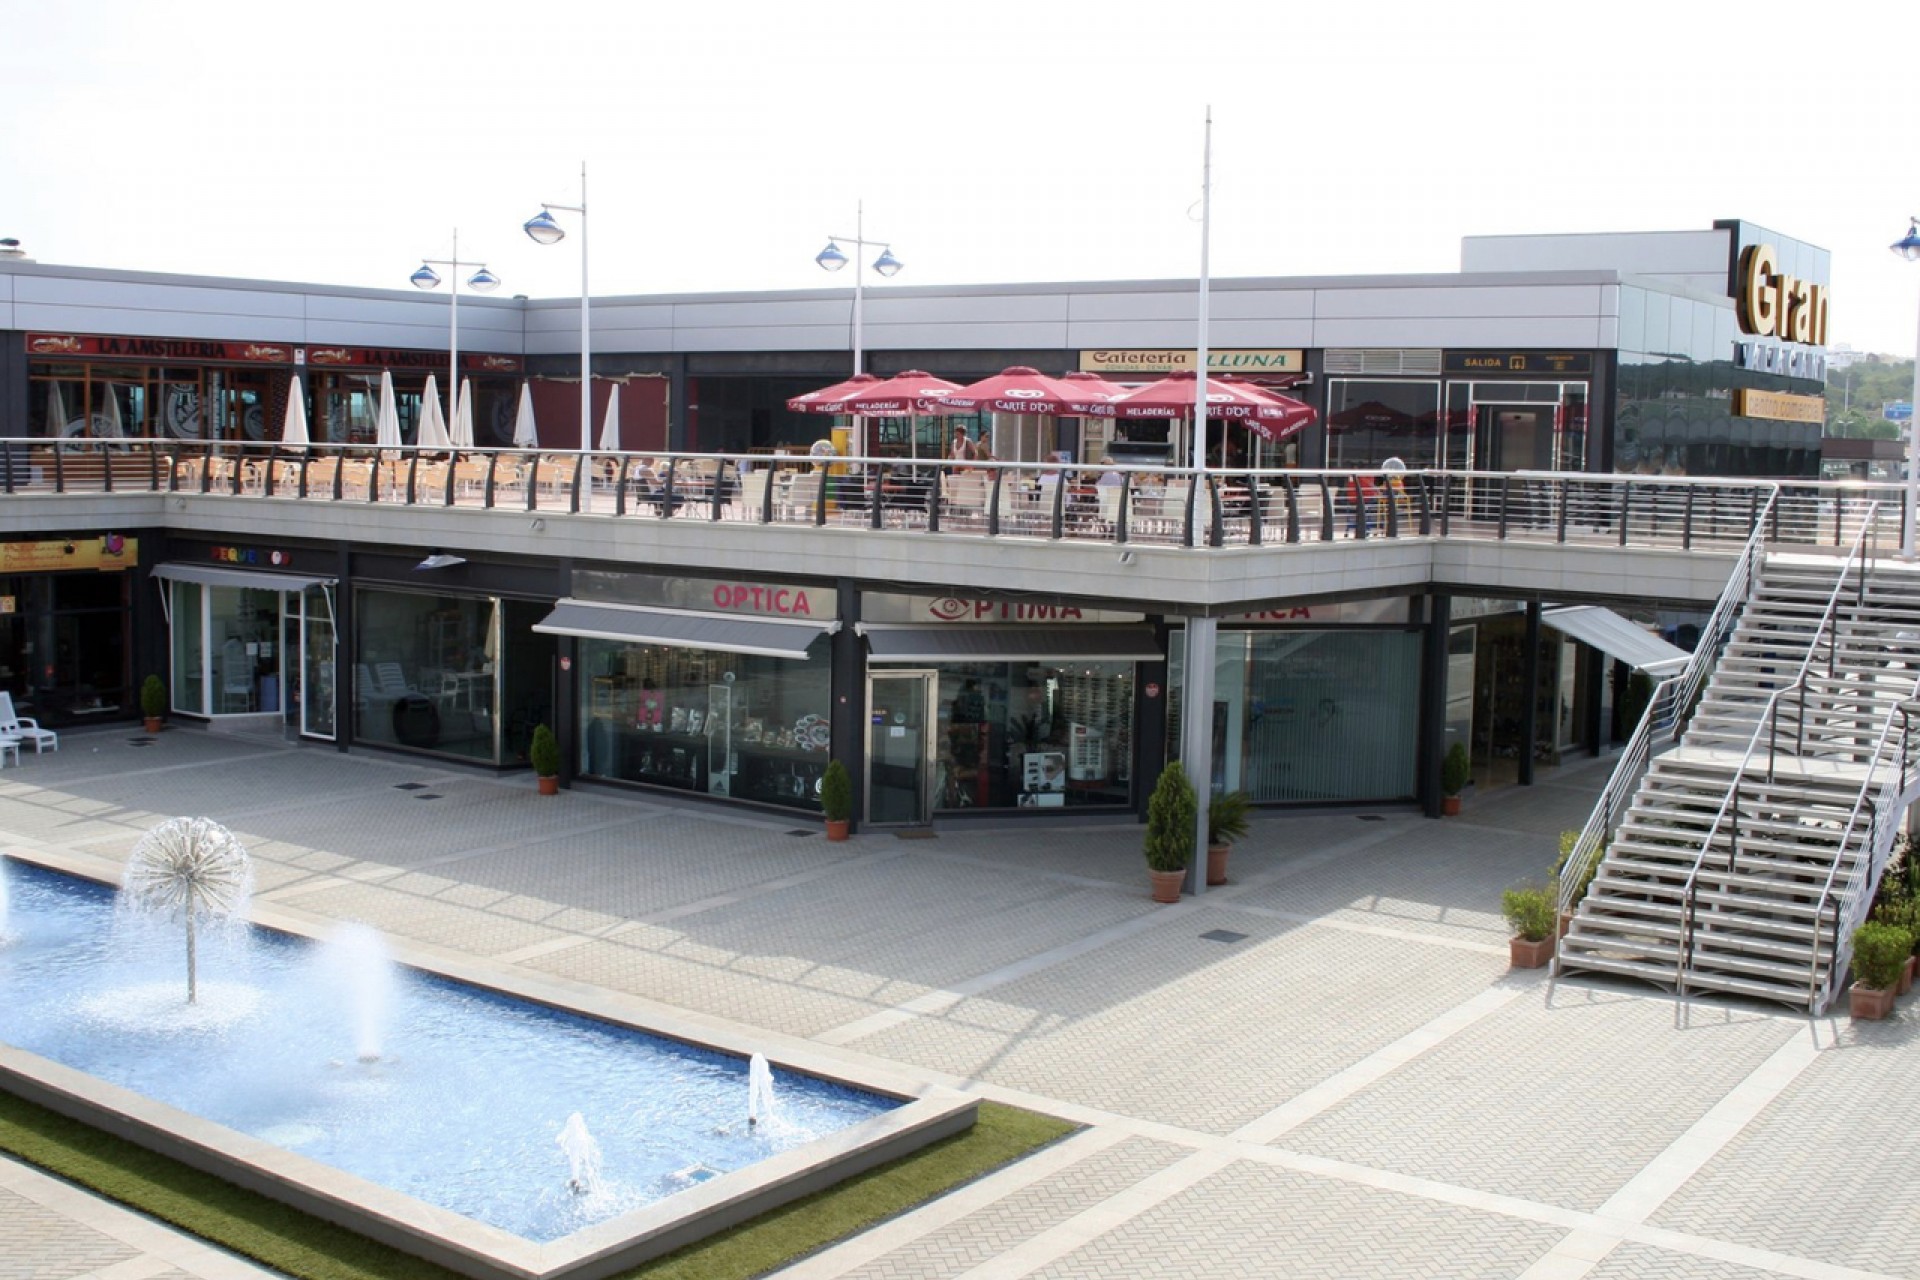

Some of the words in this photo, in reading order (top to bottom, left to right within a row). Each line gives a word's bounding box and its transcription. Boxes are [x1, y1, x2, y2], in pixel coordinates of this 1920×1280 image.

[1737, 243, 1828, 346] Gran
[1464, 358, 1501, 367] SALIDA
[994, 400, 1026, 412] CARTE
[712, 584, 812, 616] OPTICA
